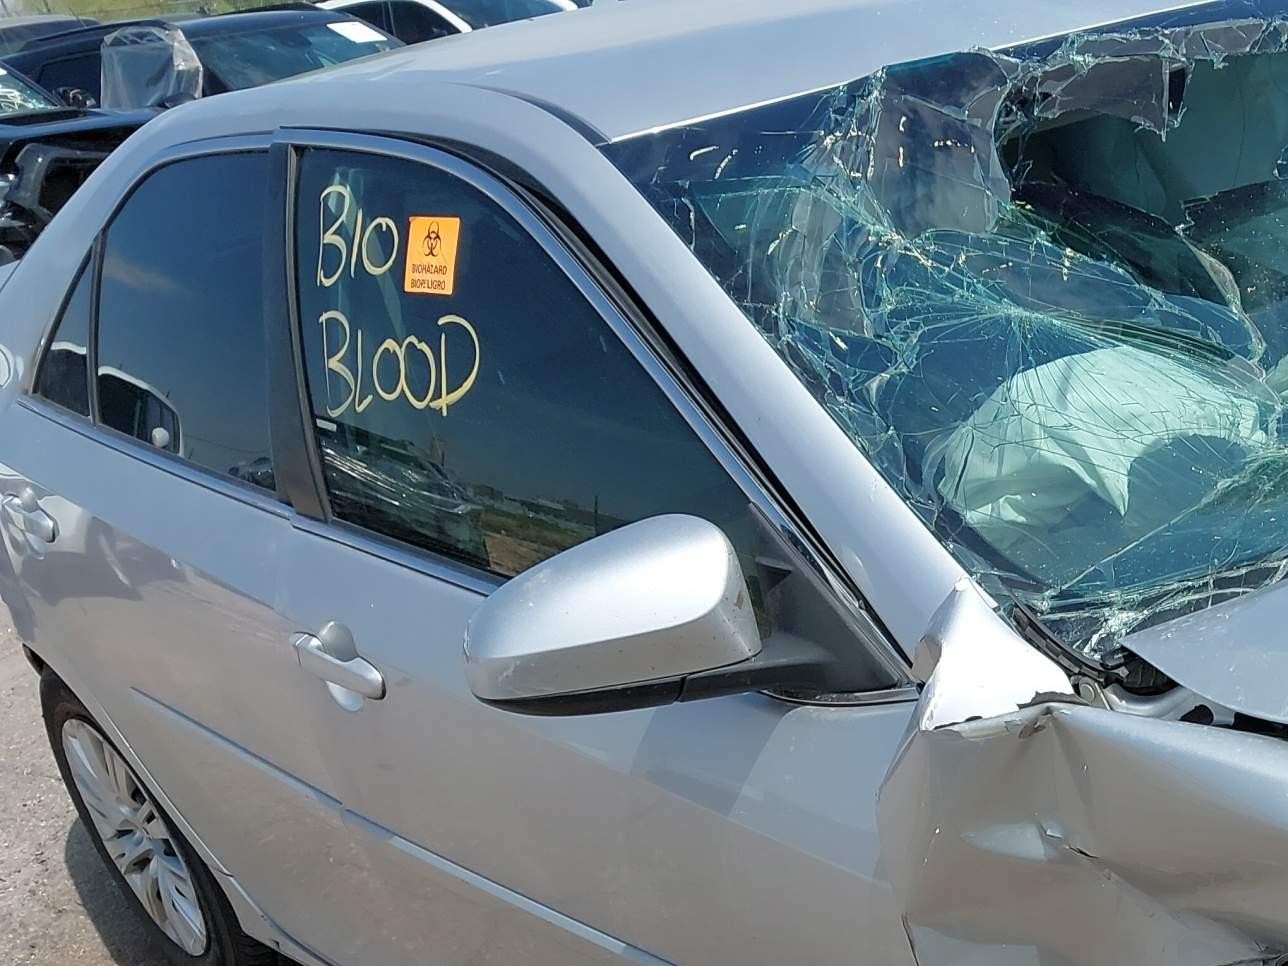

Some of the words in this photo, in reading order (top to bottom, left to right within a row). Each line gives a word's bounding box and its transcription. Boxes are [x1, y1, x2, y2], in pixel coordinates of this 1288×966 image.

[317, 184, 399, 288] BIO
[411, 263, 448, 276] BIOHAZARD
[319, 309, 481, 418] BLOOD
